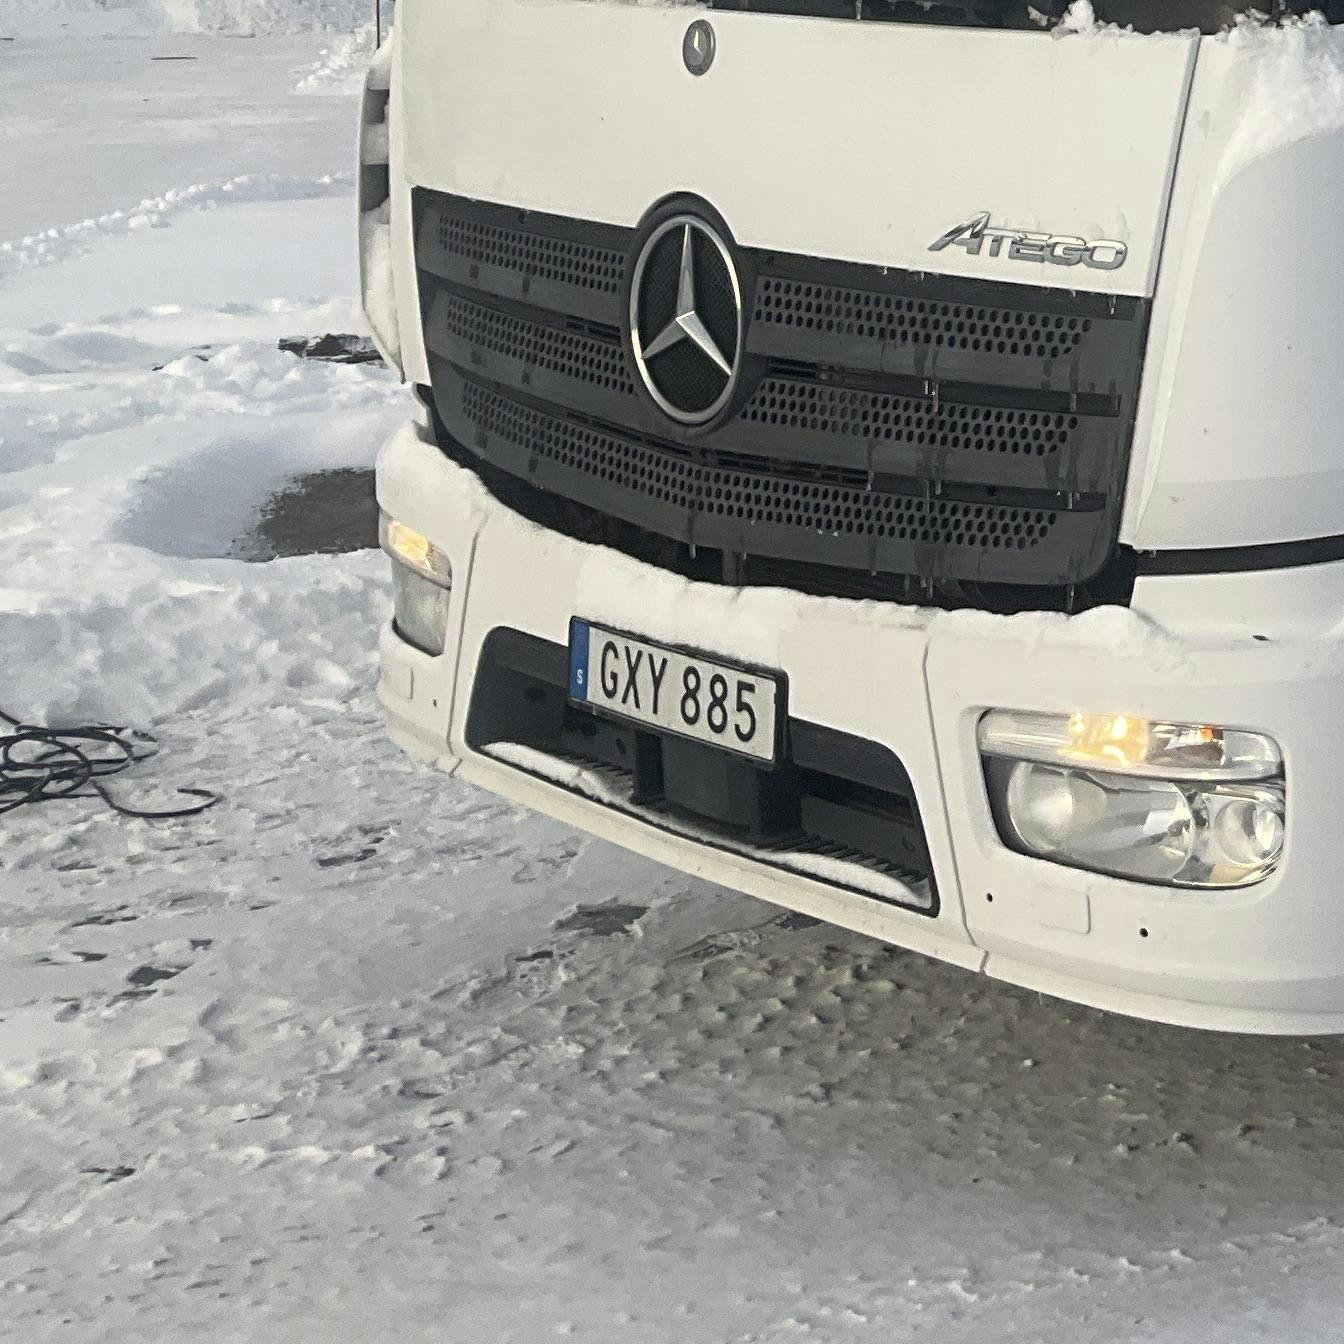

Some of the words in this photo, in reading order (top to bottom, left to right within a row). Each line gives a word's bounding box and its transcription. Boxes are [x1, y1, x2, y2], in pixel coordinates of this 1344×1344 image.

[927, 210, 1129, 271] ATEGO
[576, 668, 584, 686] S
[601, 640, 668, 715] GXY
[680, 665, 757, 742] 885
